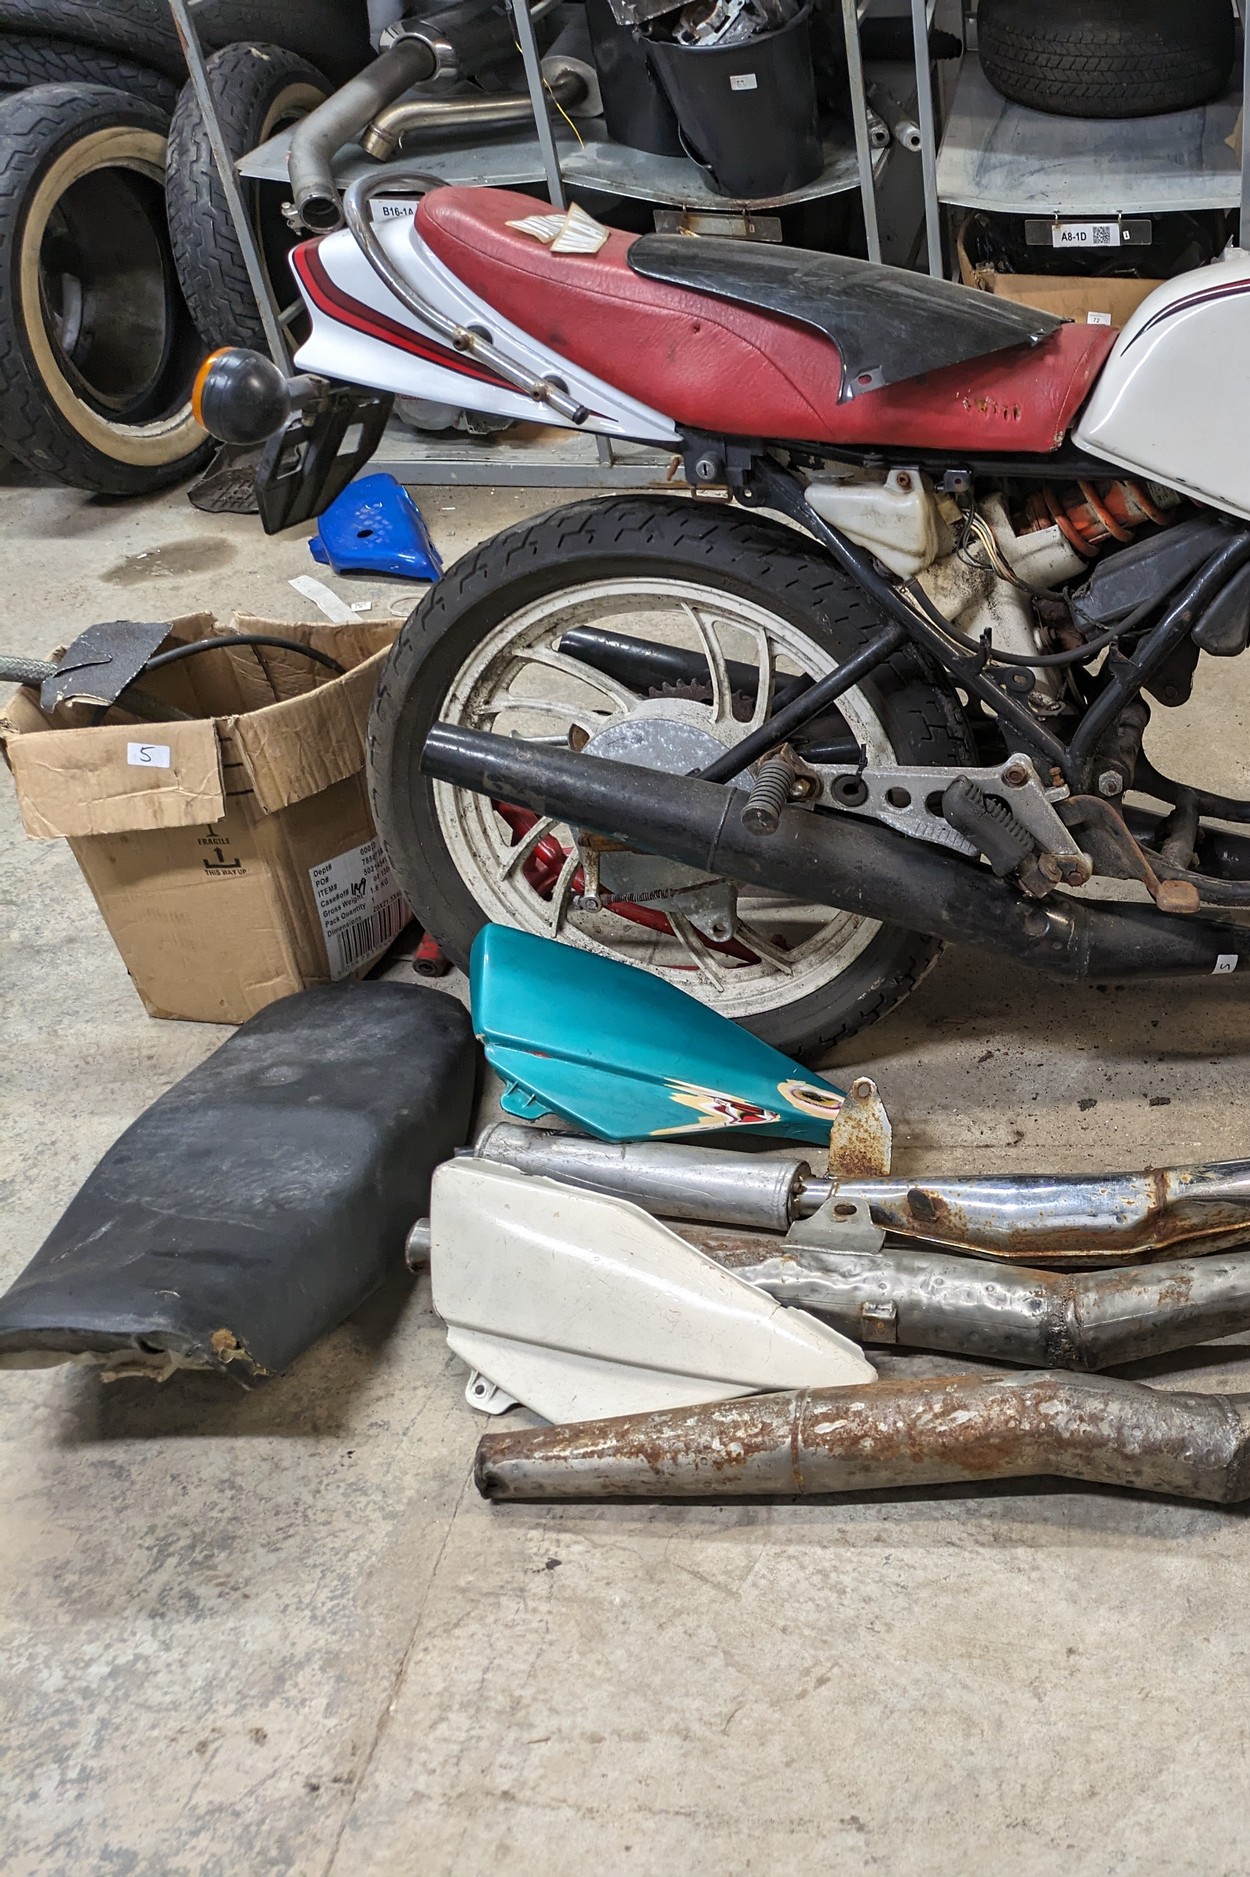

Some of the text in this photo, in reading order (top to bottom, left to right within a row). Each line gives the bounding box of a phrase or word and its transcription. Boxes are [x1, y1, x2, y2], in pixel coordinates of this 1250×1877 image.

[382, 206, 414, 216] B16-1A
[1061, 231, 1087, 242] A8-1D
[139, 746, 156, 763] 5
[197, 837, 232, 846] FRAGILE
[204, 868, 221, 876] THIS
[313, 863, 333, 878] Dept#
[315, 876, 330, 888] PO#
[317, 883, 338, 898] ITEM#
[322, 904, 342, 919] Gross
[324, 915, 341, 928] Pack
[340, 902, 367, 920] Quantity
